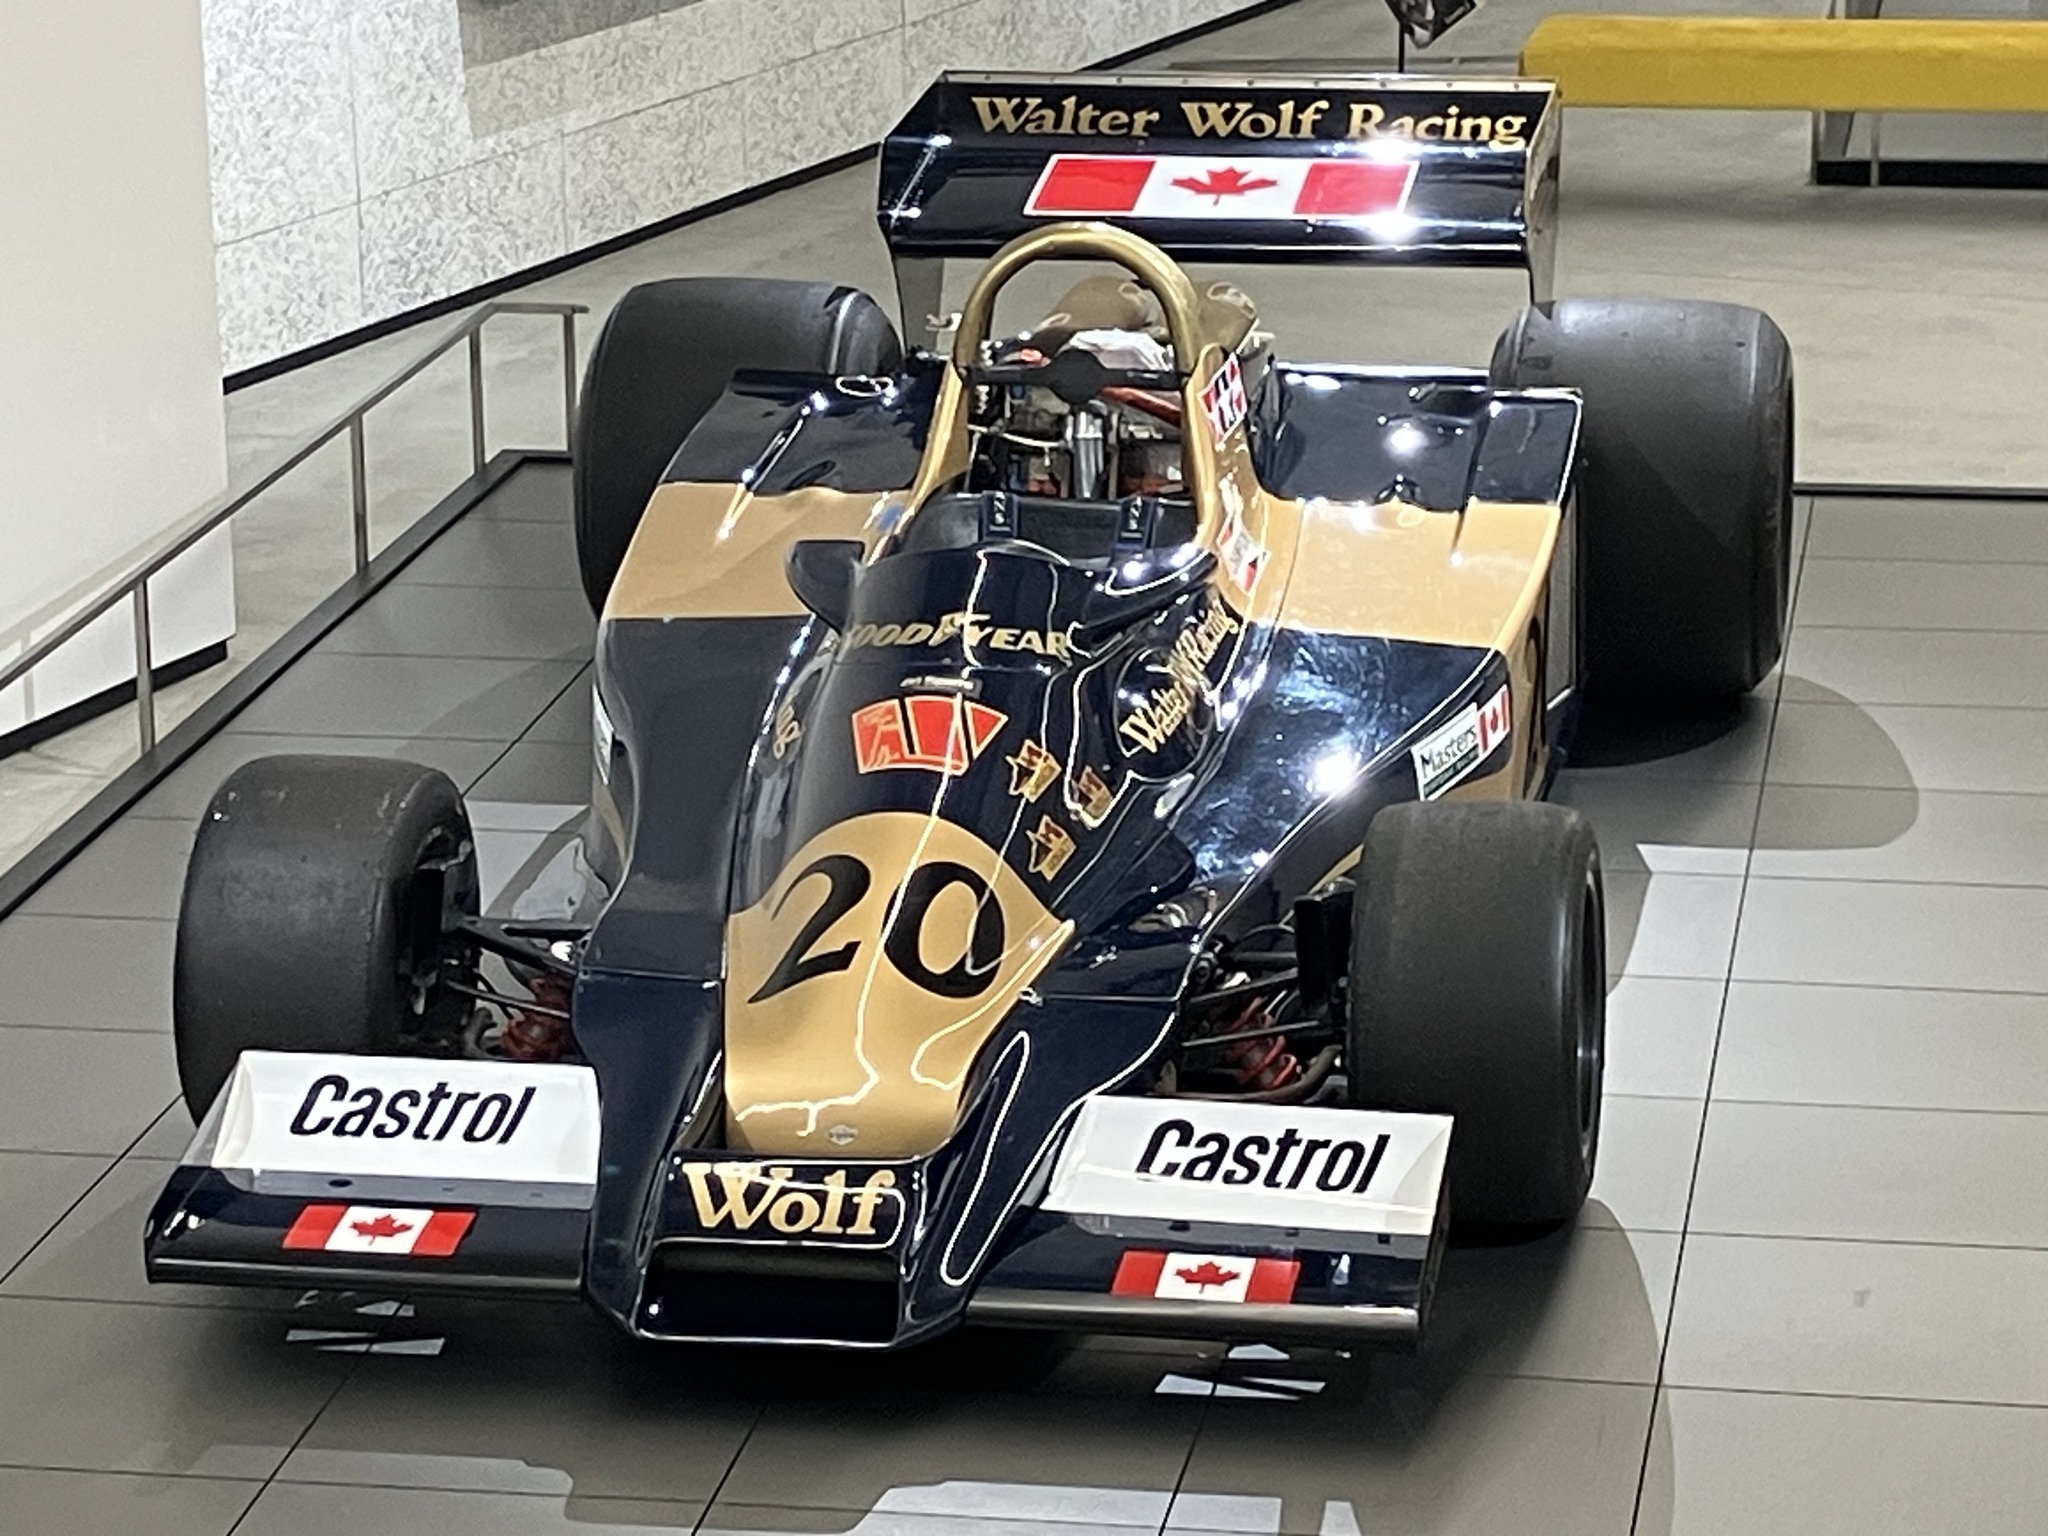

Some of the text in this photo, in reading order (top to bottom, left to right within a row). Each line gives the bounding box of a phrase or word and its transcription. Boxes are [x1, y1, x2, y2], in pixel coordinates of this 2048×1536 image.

[971, 94, 1528, 152] Walter Wolf Racing
[1419, 724, 1477, 778] Masters
[747, 854, 1006, 1005] 20
[289, 1074, 538, 1145] Castrol
[1134, 1118, 1391, 1194] Castrol
[682, 1162, 896, 1236] Wolf
